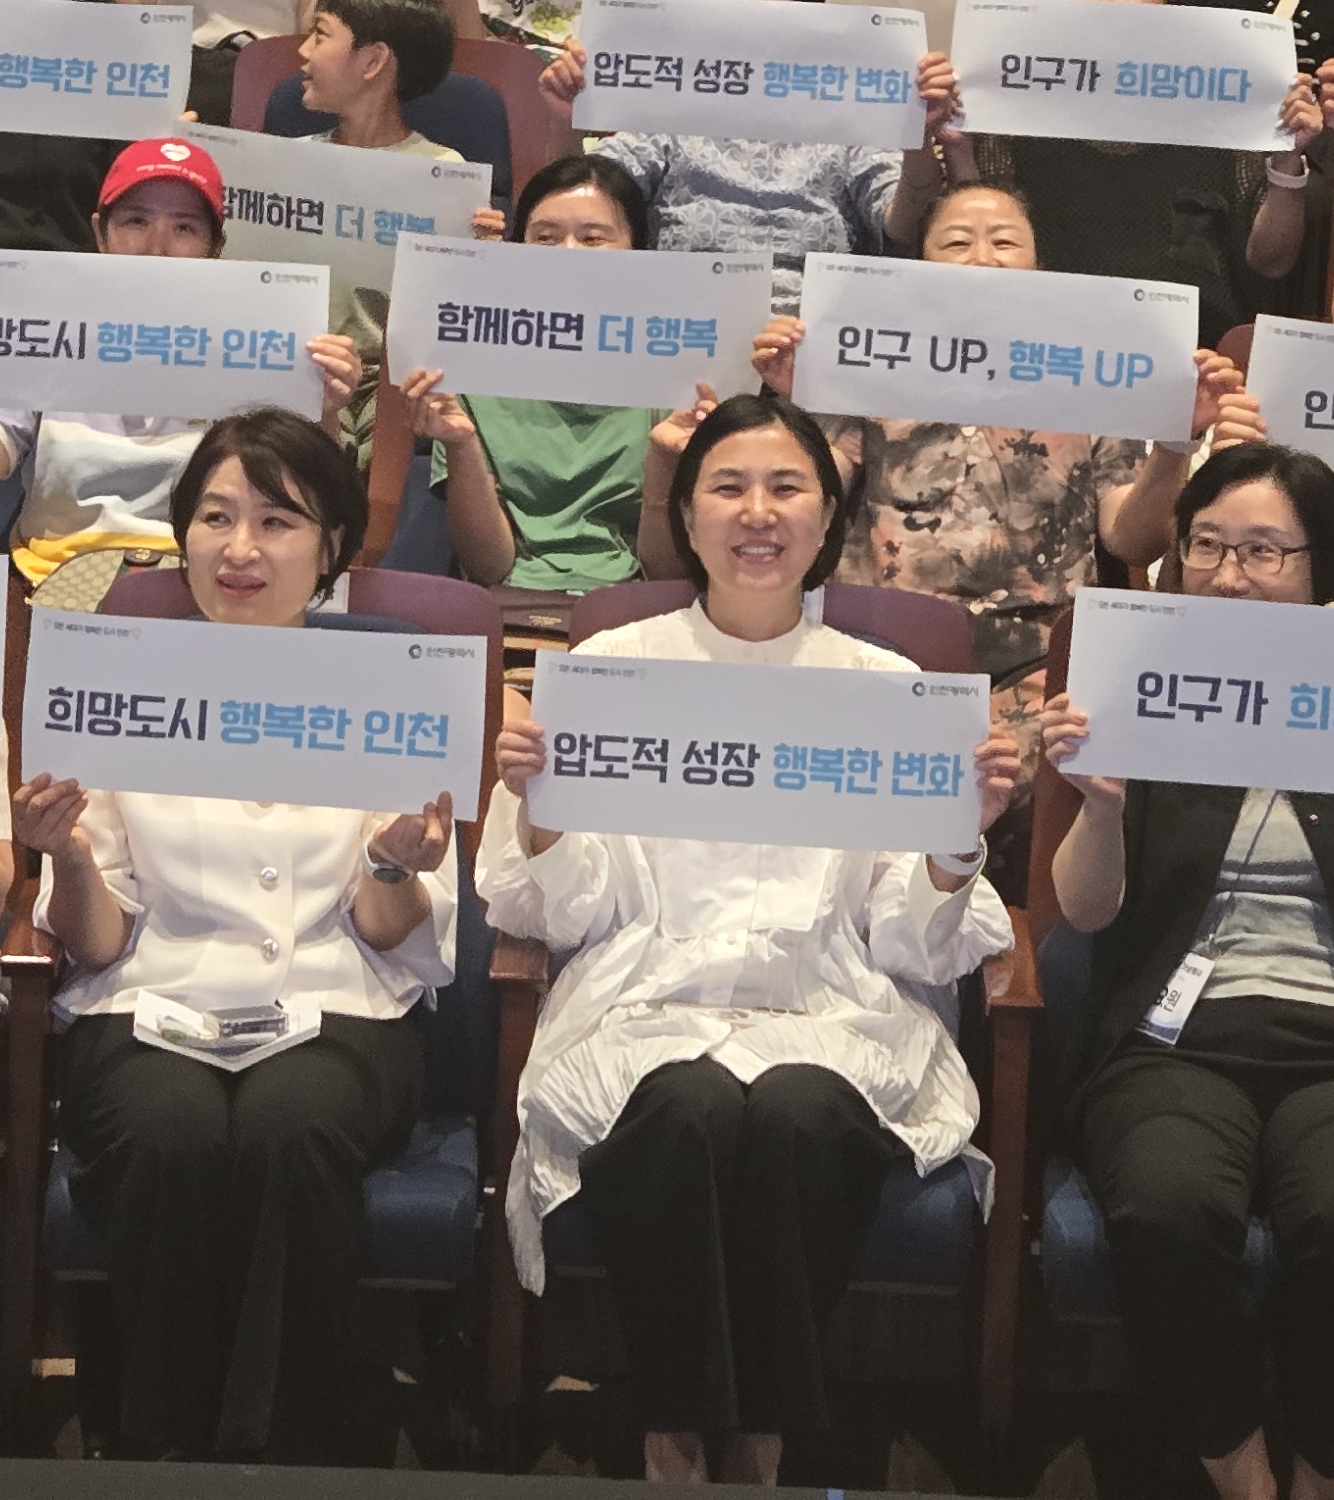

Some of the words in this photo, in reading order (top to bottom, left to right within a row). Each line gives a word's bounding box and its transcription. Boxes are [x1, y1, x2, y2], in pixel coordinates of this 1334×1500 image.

[106, 62, 169, 98] 인천
[593, 51, 683, 92] 압도적
[693, 58, 755, 95] 성장
[764, 61, 848, 101] 행복한
[855, 68, 911, 103] 변화
[1000, 54, 1101, 94] 인구가
[1115, 60, 1251, 102] 희망이다
[97, 322, 211, 366] 행복한
[222, 329, 295, 371] 인천
[437, 301, 584, 351] 함께하면
[598, 315, 633, 353] 더
[646, 316, 717, 357] 행복
[837, 325, 911, 370] 인구
[929, 335, 995, 381] UP,
[1009, 340, 1084, 385] 행복
[1095, 350, 1153, 388] UP
[44, 686, 207, 741] 희망도시
[220, 700, 352, 751] 행복한
[364, 710, 448, 758] 인천
[1136, 671, 1269, 725] 인구가
[553, 732, 669, 783] 압도적
[681, 740, 761, 787] 성장
[773, 743, 882, 795] 행복한
[892, 751, 964, 797] 변화
